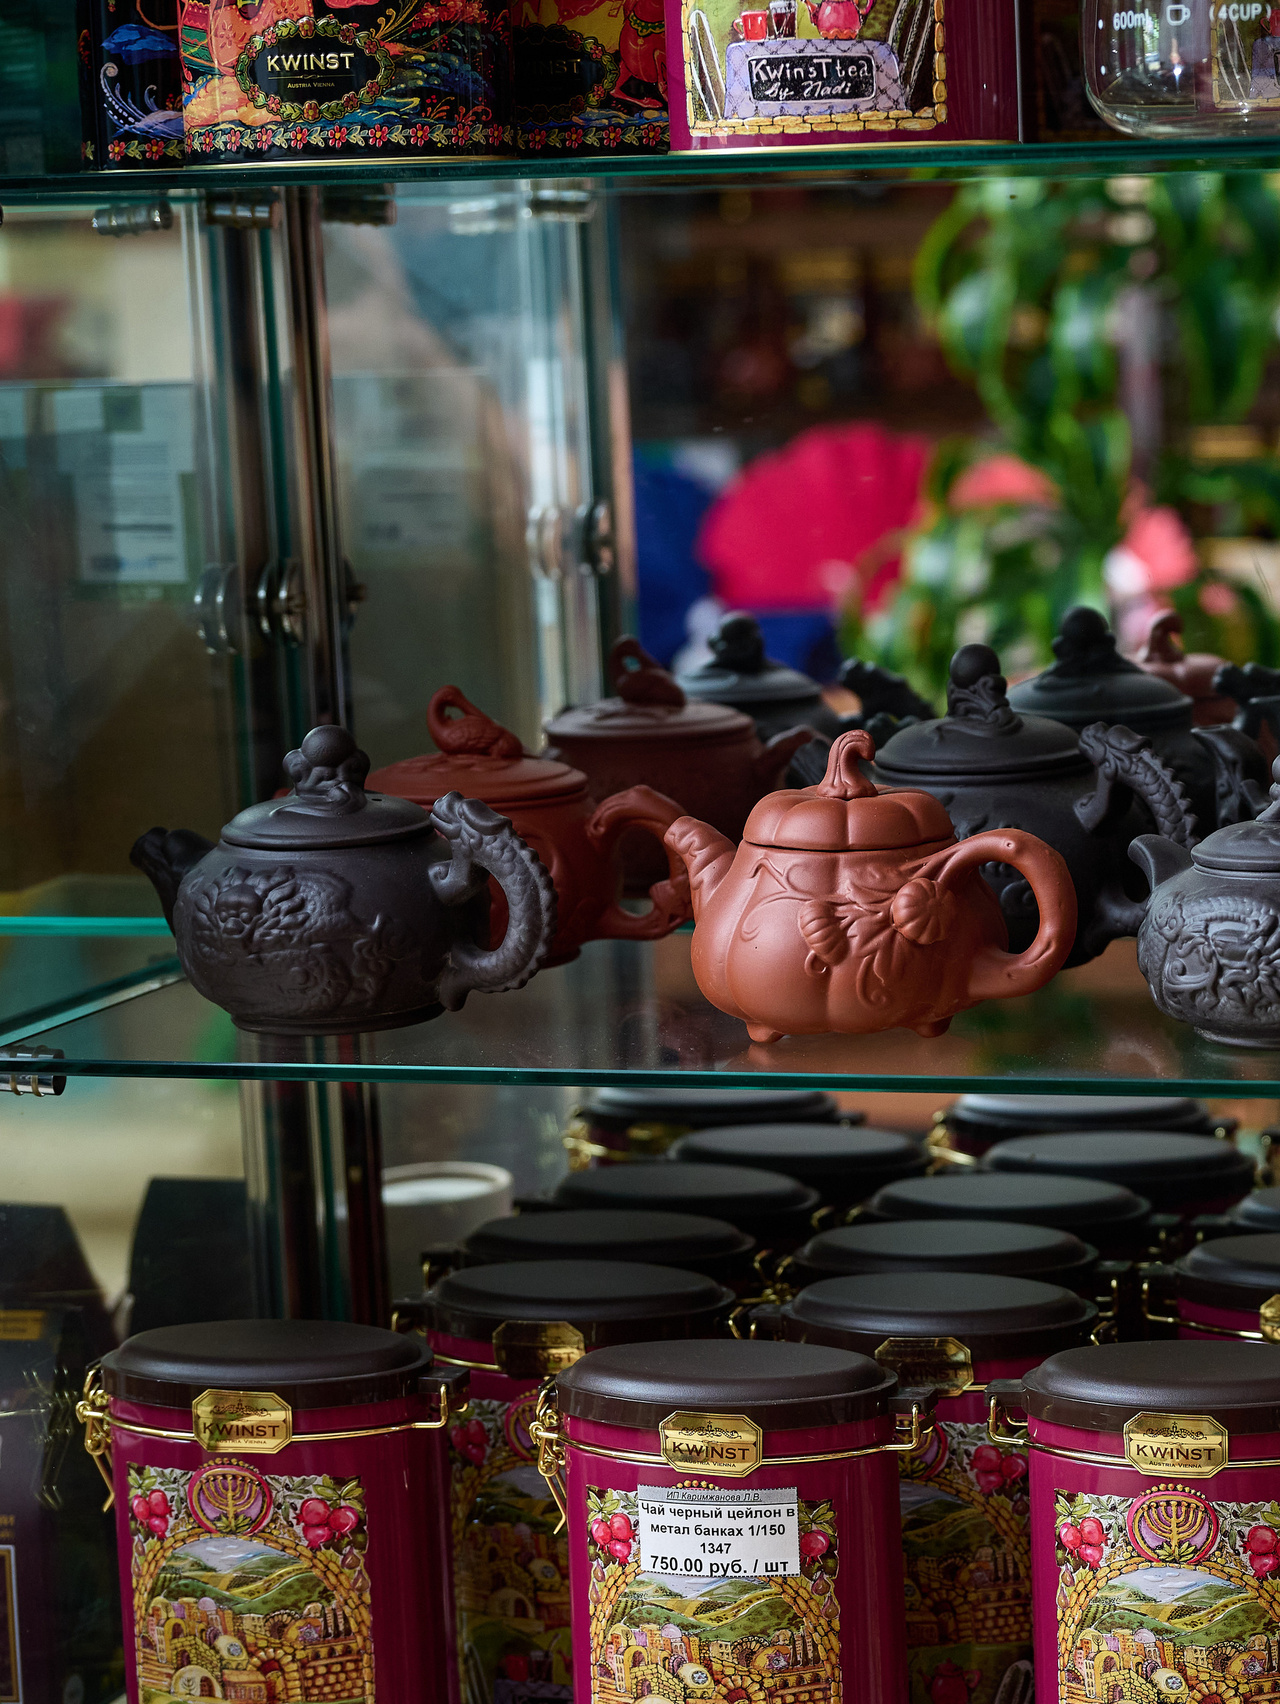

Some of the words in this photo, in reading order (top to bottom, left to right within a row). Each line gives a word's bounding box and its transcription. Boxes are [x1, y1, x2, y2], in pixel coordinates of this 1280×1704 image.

[267, 53, 355, 72] KWINST
[750, 58, 832, 83] KwinsT
[835, 59, 872, 78] tea
[203, 1422, 280, 1438] KWINST
[672, 1442, 750, 1461] KWINST
[1136, 1444, 1216, 1461] KWINST
[666, 1490, 681, 1500] ИП
[681, 1491, 742, 1502] Каримжанова
[742, 1492, 763, 1501] Л.В.
[641, 1502, 665, 1516] Чай
[669, 1507, 723, 1520] черный
[727, 1507, 782, 1520] цейлон
[786, 1508, 795, 1517] в
[650, 1523, 690, 1535] метал
[694, 1525, 744, 1536] банках
[748, 1523, 786, 1536] 1/150
[700, 1542, 732, 1554] 1347
[650, 1555, 703, 1573] 750.00
[709, 1558, 748, 1576] руб.
[753, 1559, 759, 1573] /
[764, 1560, 789, 1573] шт
